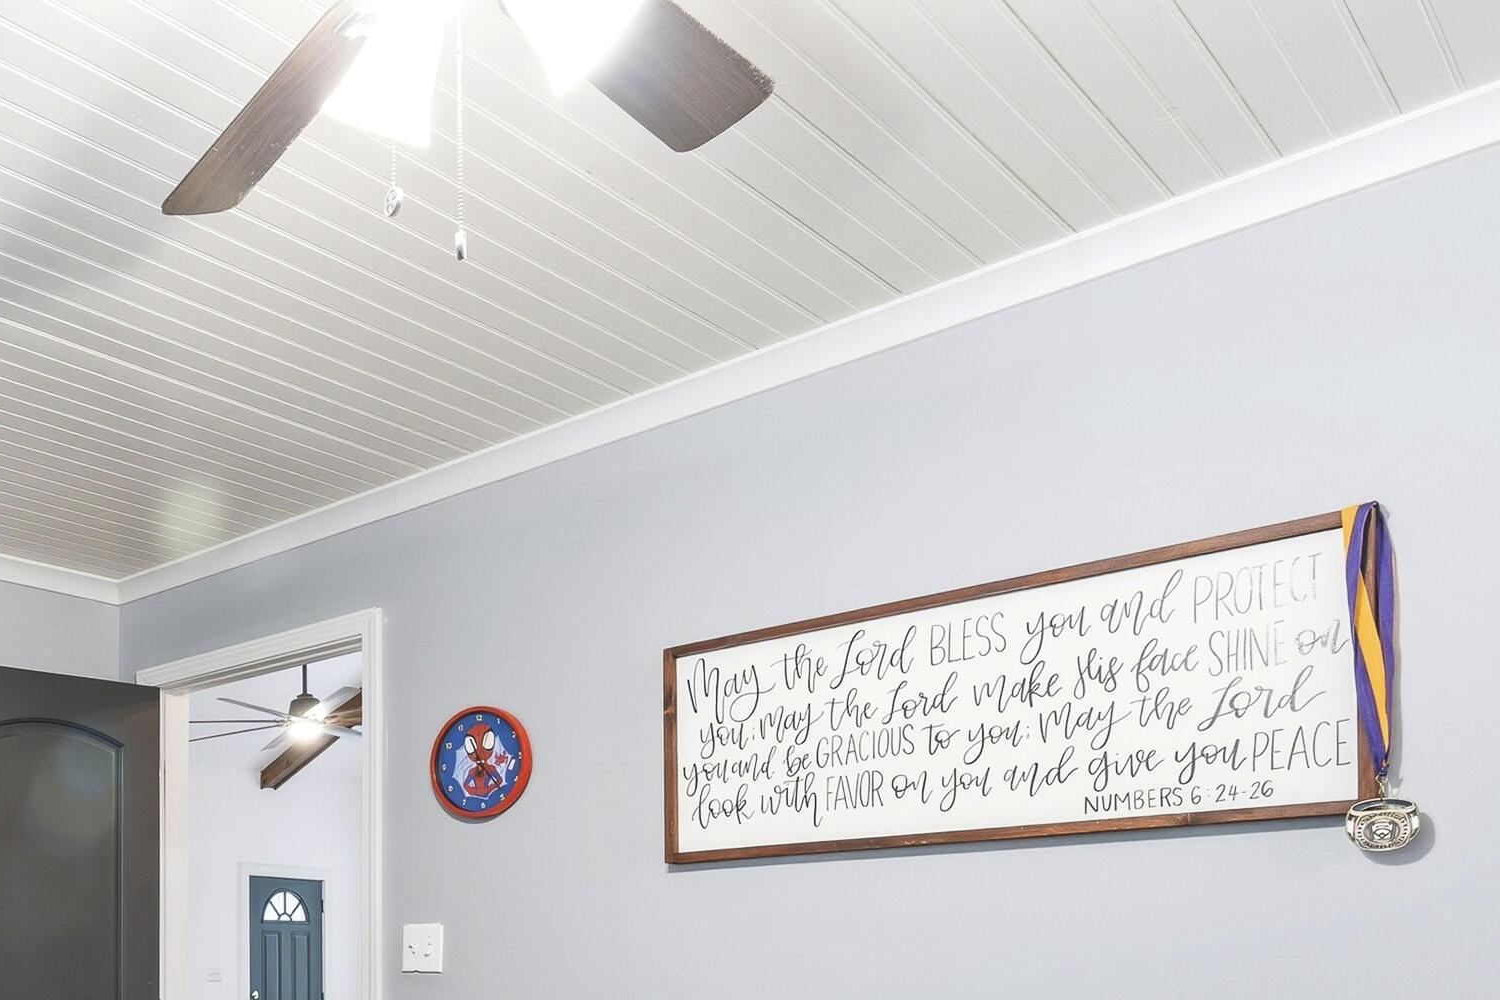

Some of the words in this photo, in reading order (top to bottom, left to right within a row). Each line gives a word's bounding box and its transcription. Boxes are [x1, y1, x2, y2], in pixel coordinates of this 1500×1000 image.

[687, 658, 776, 724] May
[770, 644, 828, 693] the
[830, 625, 917, 689] Lord
[930, 612, 1007, 666] BLESS
[1019, 606, 1092, 665] you
[1100, 569, 1184, 636] and
[1193, 552, 1323, 624] PROTECT
[824, 688, 878, 731] the
[882, 671, 958, 724] Lord
[973, 660, 1063, 713] make
[1073, 647, 1124, 700] His
[1130, 638, 1199, 693] face
[1208, 620, 1288, 677] SHINE
[1295, 618, 1350, 655] on
[683, 759, 729, 797] you
[731, 746, 777, 781] and
[783, 745, 812, 777] be
[816, 723, 915, 768] GRACIOUS
[921, 723, 961, 756] to
[1130, 686, 1193, 730] the
[1197, 664, 1326, 732] Lord
[692, 783, 754, 829] look
[761, 772, 823, 827] with
[826, 770, 883, 811] FAVOR
[891, 770, 933, 804] on
[939, 767, 992, 812] you
[1003, 746, 1079, 797] and
[1088, 750, 1165, 792] give
[1174, 738, 1247, 785] you
[1253, 718, 1351, 772] PEACE
[1084, 787, 1183, 814] NUMBERS
